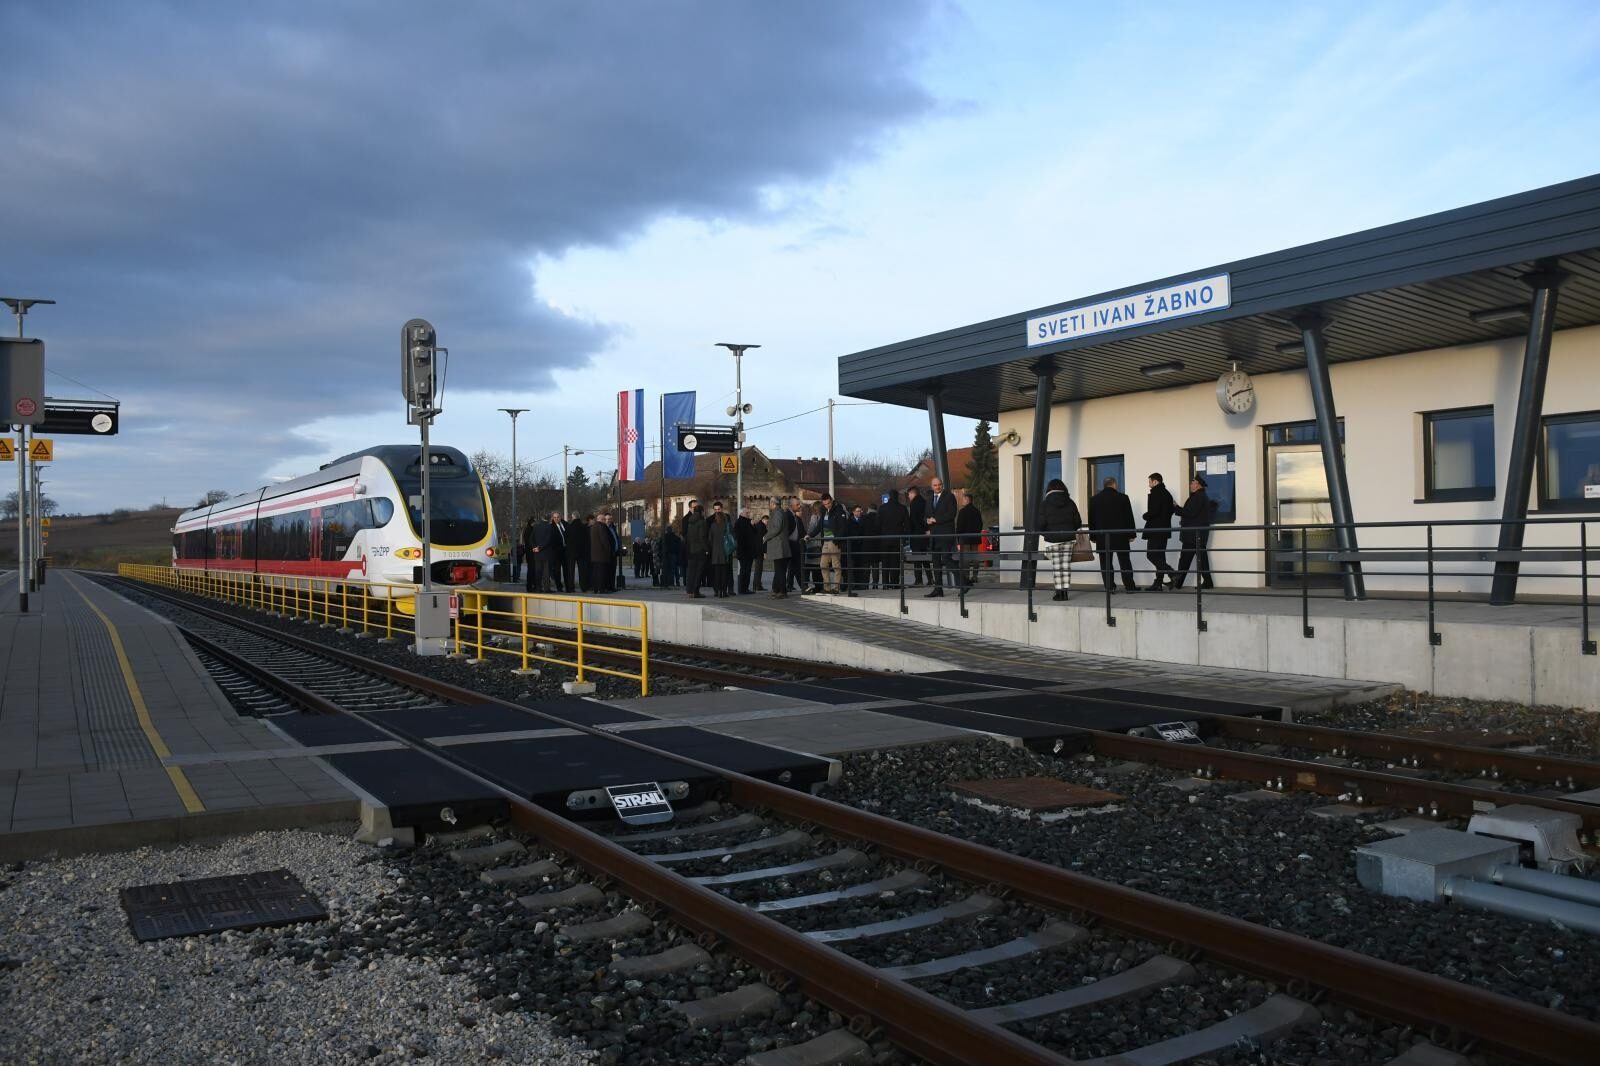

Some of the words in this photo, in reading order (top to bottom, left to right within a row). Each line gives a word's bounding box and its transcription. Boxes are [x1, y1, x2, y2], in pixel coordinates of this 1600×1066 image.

[1038, 314, 1085, 338] SVETI
[1093, 302, 1136, 327] IVAN
[1144, 285, 1214, 316] ŽABNO
[614, 792, 665, 809] STRAIL
